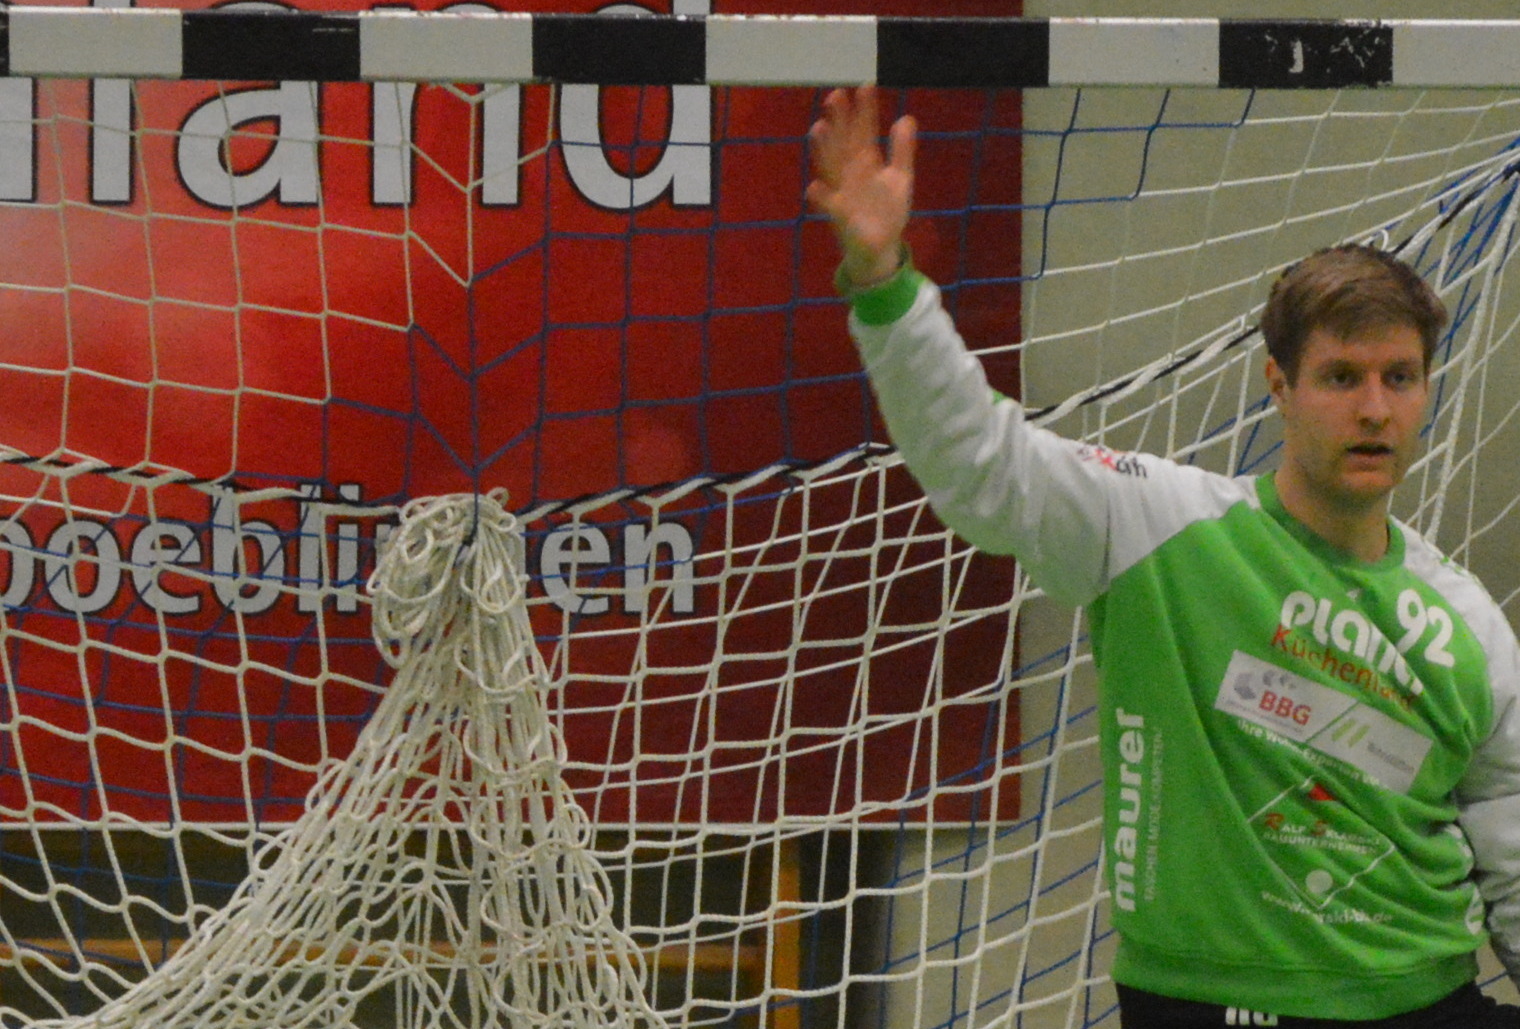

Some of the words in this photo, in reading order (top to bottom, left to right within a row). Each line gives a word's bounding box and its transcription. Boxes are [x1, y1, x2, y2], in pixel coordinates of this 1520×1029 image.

[1396, 588, 1456, 668] 92
[1259, 690, 1312, 727] BBG
[1114, 706, 1145, 912] maurer
